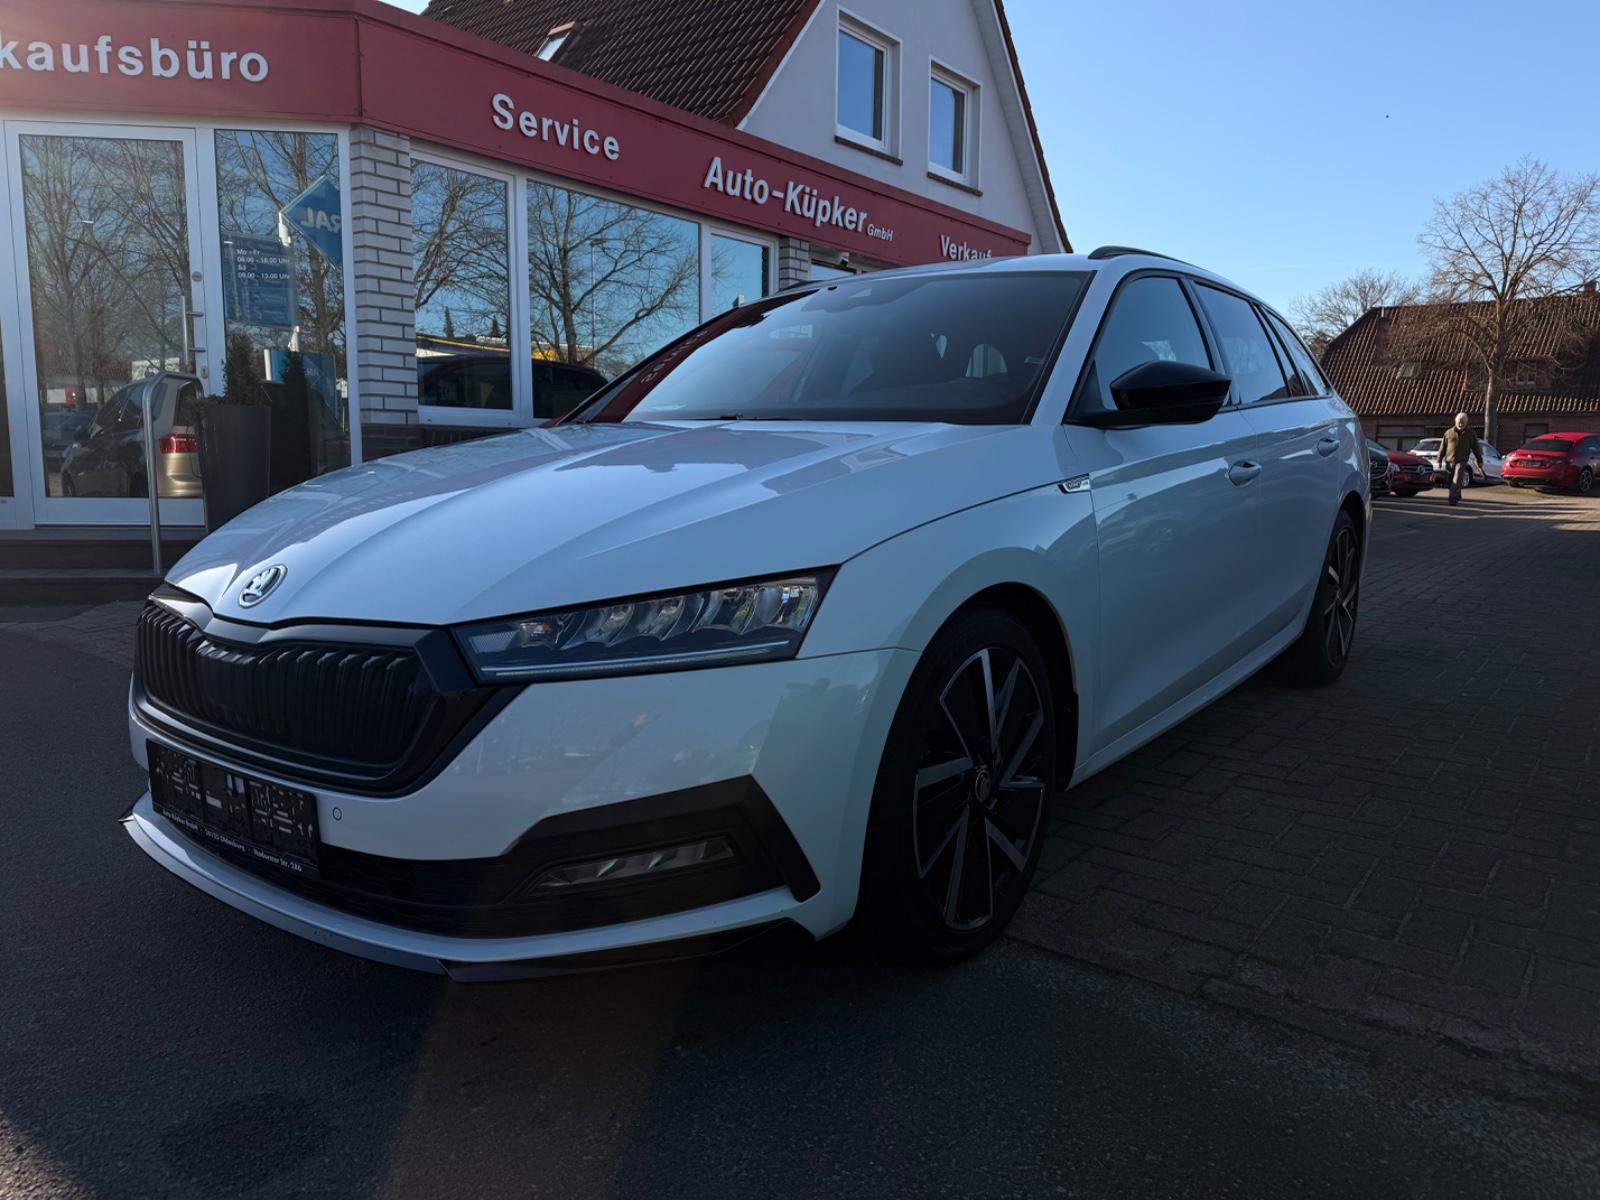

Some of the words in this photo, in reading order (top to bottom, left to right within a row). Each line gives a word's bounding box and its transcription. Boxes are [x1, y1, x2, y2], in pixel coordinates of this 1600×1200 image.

[0, 32, 269, 83] kaufsbüro
[491, 93, 621, 160] Service
[703, 156, 868, 234] Auto-Küpker
[867, 223, 894, 242] GmbH
